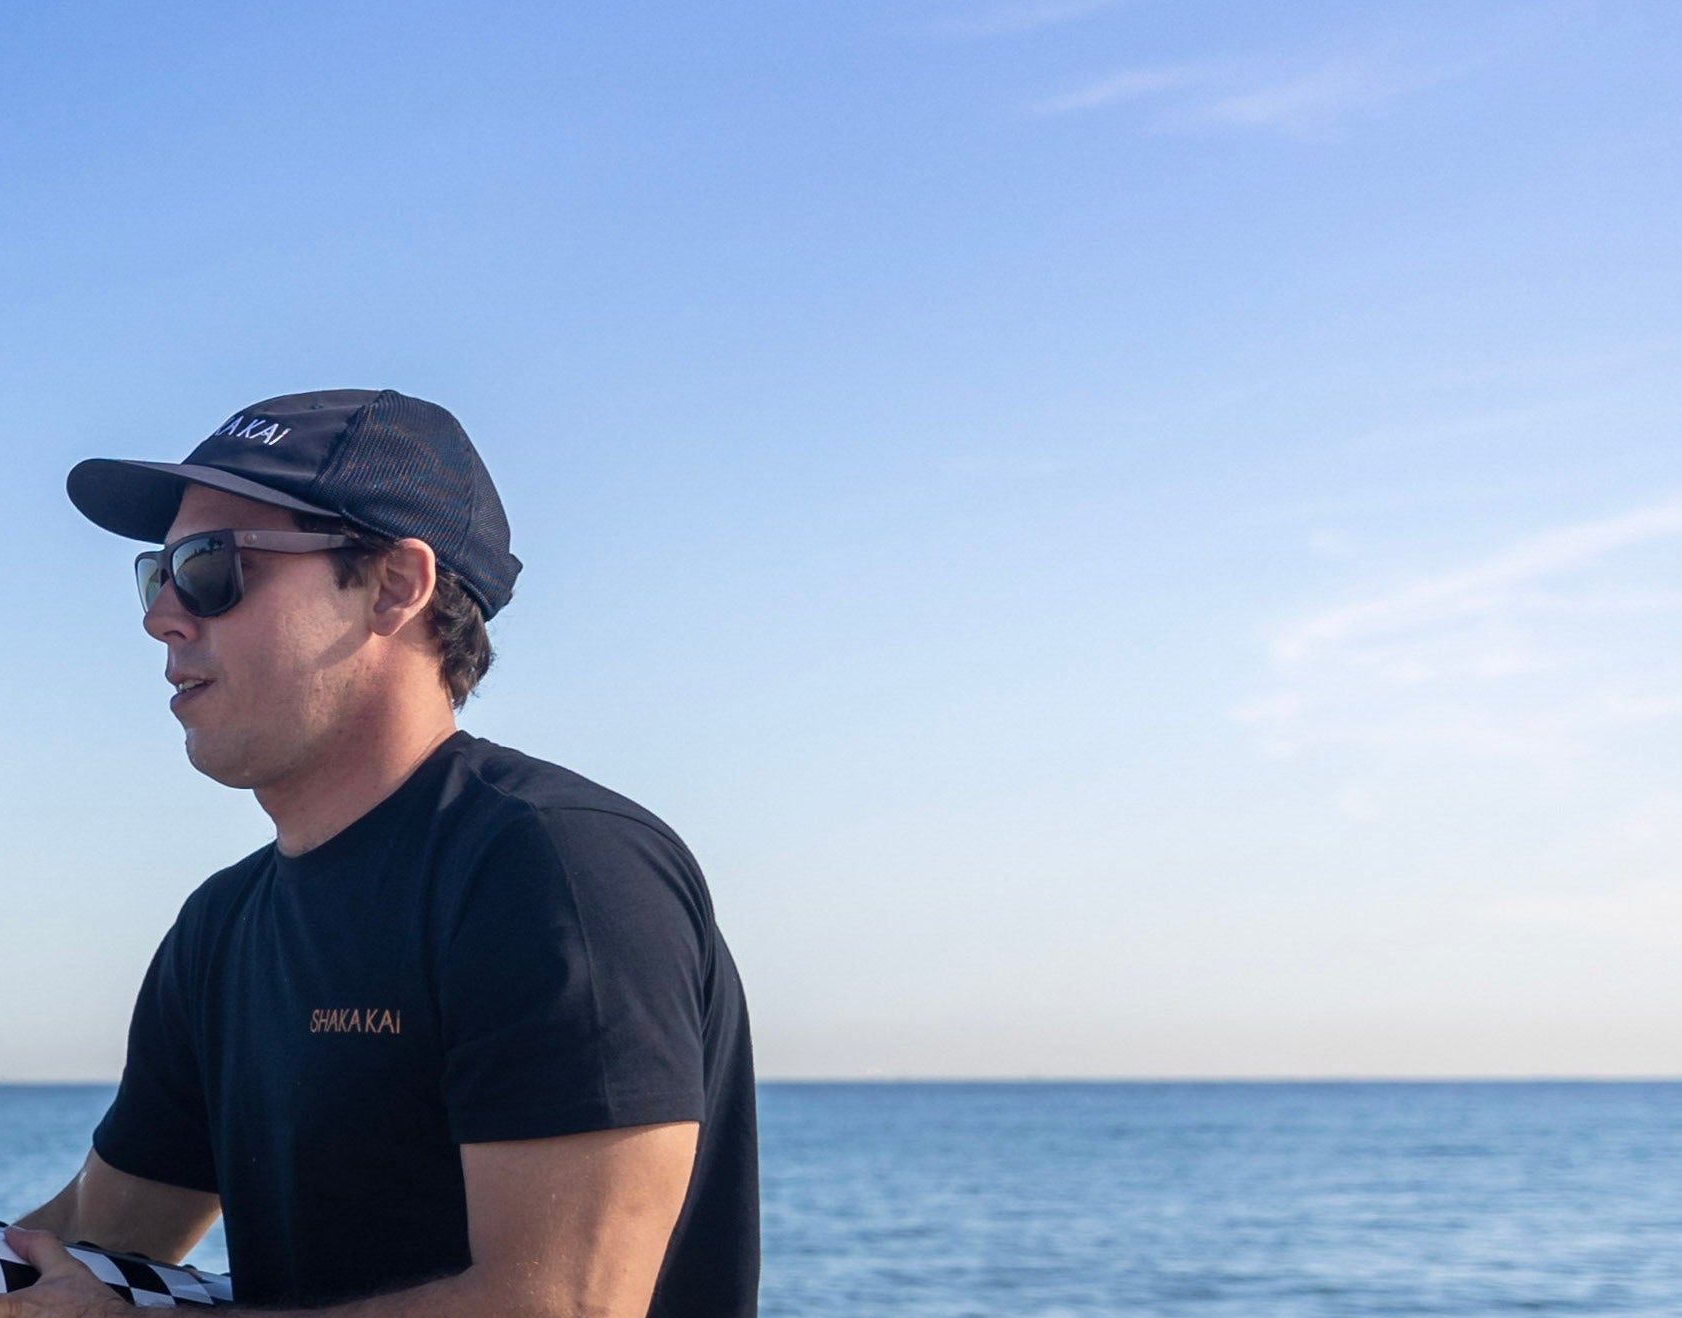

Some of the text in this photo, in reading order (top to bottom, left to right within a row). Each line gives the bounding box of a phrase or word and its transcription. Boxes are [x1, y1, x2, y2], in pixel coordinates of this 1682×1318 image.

[236, 419, 292, 446] KAI
[310, 1009, 401, 1034] SHAKA KAI
